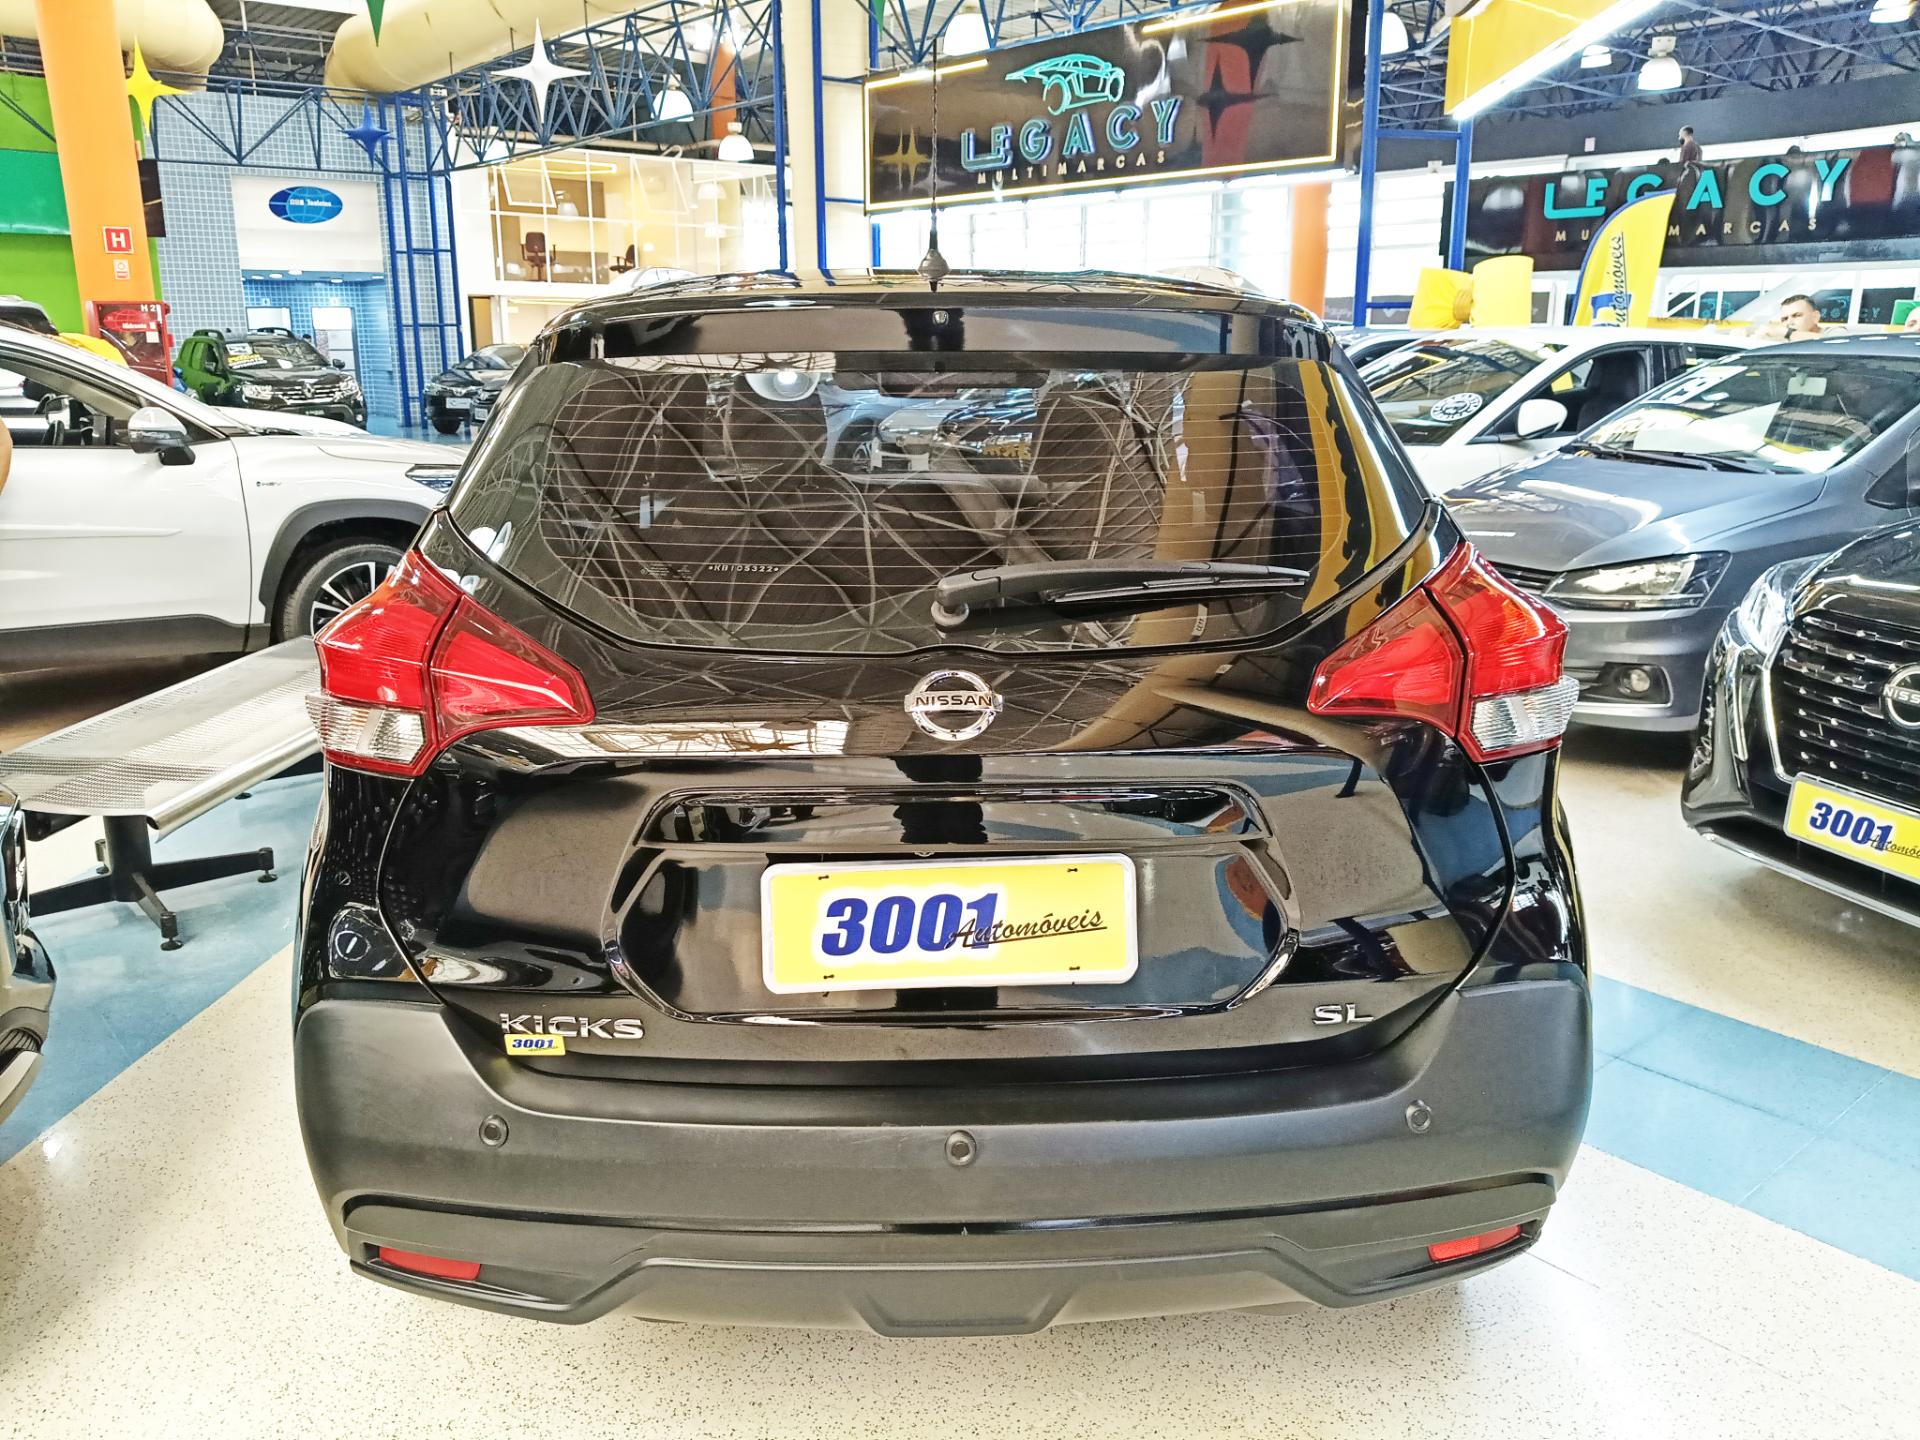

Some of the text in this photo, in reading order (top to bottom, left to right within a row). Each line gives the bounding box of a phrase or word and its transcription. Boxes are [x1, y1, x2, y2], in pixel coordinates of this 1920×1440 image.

[961, 97, 1182, 172] LEGACY
[977, 150, 1166, 185] MULTIMARCAS
[111, 232, 126, 248] H
[1554, 216, 1818, 243] MUMARCAS
[915, 694, 993, 707] NISSAN
[1883, 683, 1920, 704] NISS
[1809, 802, 1893, 852] 3001
[821, 892, 999, 957] 3001
[944, 908, 1109, 951] Automóveis
[499, 1012, 645, 1040] KICKS
[1312, 1003, 1374, 1025] SL
[512, 1038, 555, 1049] 3001
